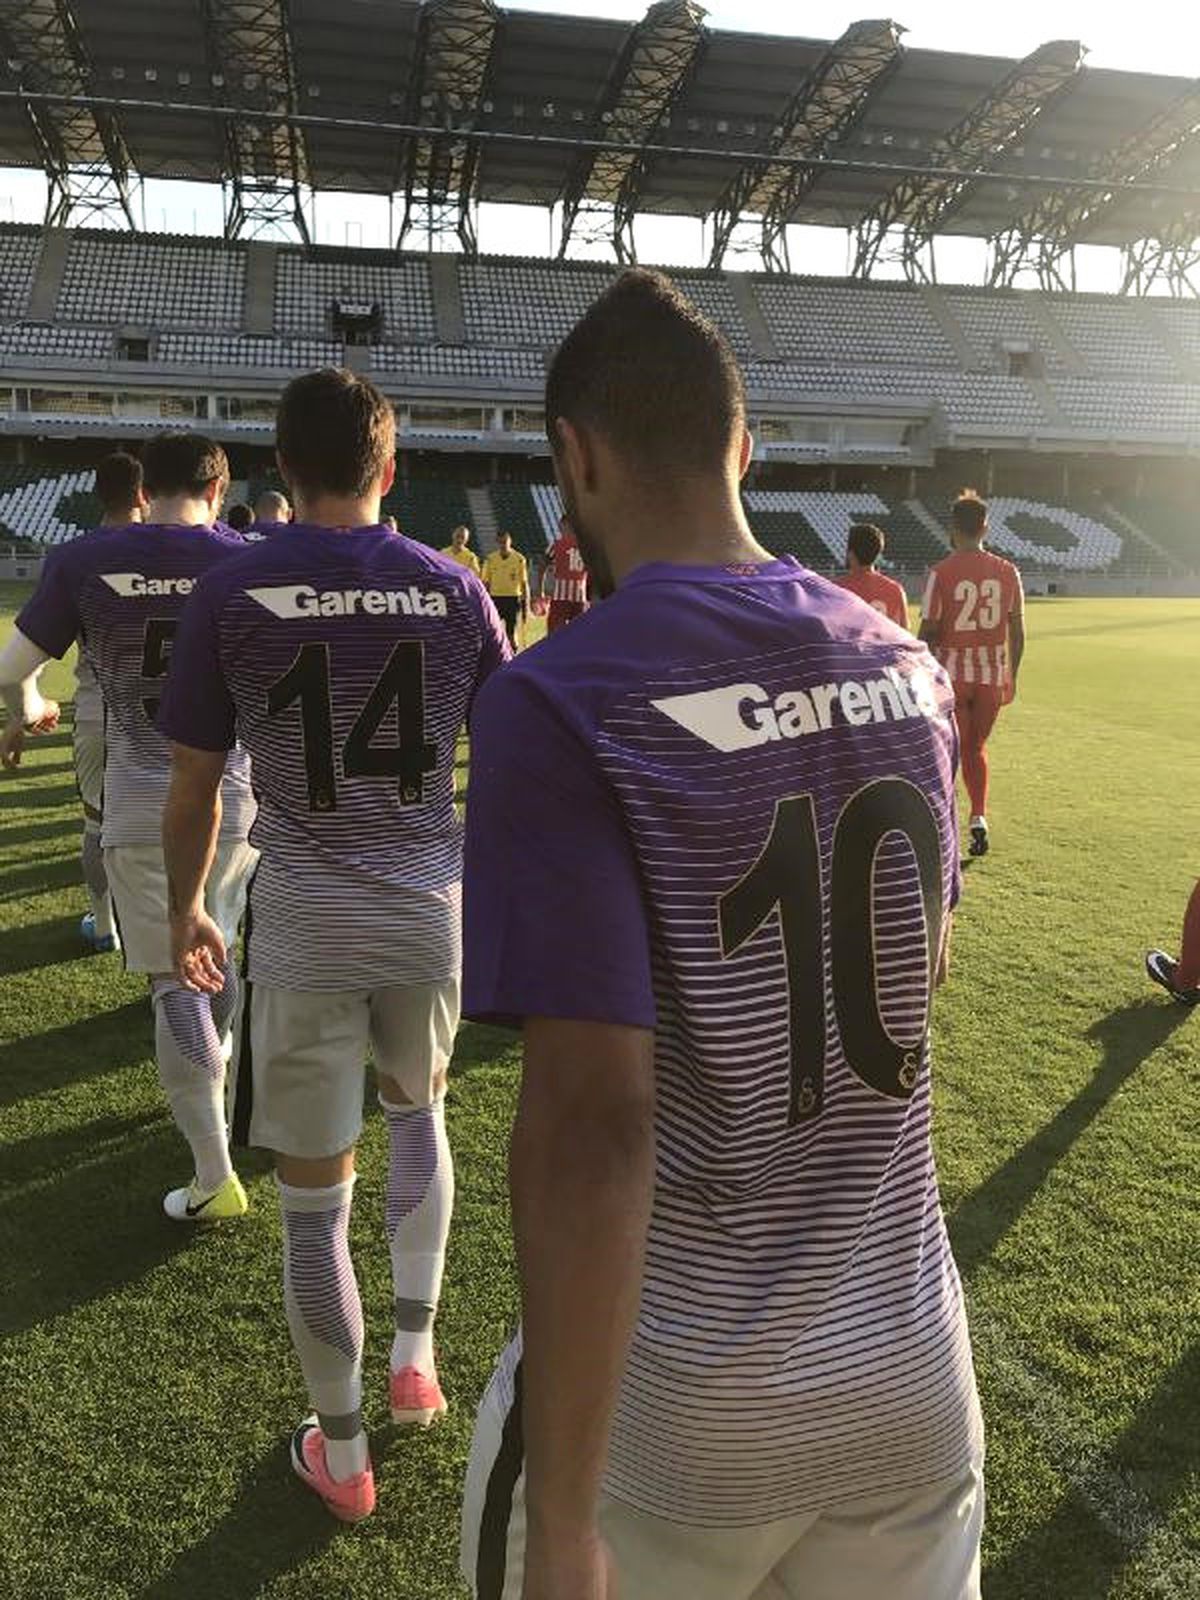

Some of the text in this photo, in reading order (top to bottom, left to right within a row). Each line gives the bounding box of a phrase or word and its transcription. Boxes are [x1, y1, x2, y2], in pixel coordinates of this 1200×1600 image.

[100, 573, 197, 596] Gare
[243, 585, 448, 619] Garenta
[954, 579, 1002, 631] 23
[266, 640, 438, 811] 14
[717, 777, 943, 1124] 10
